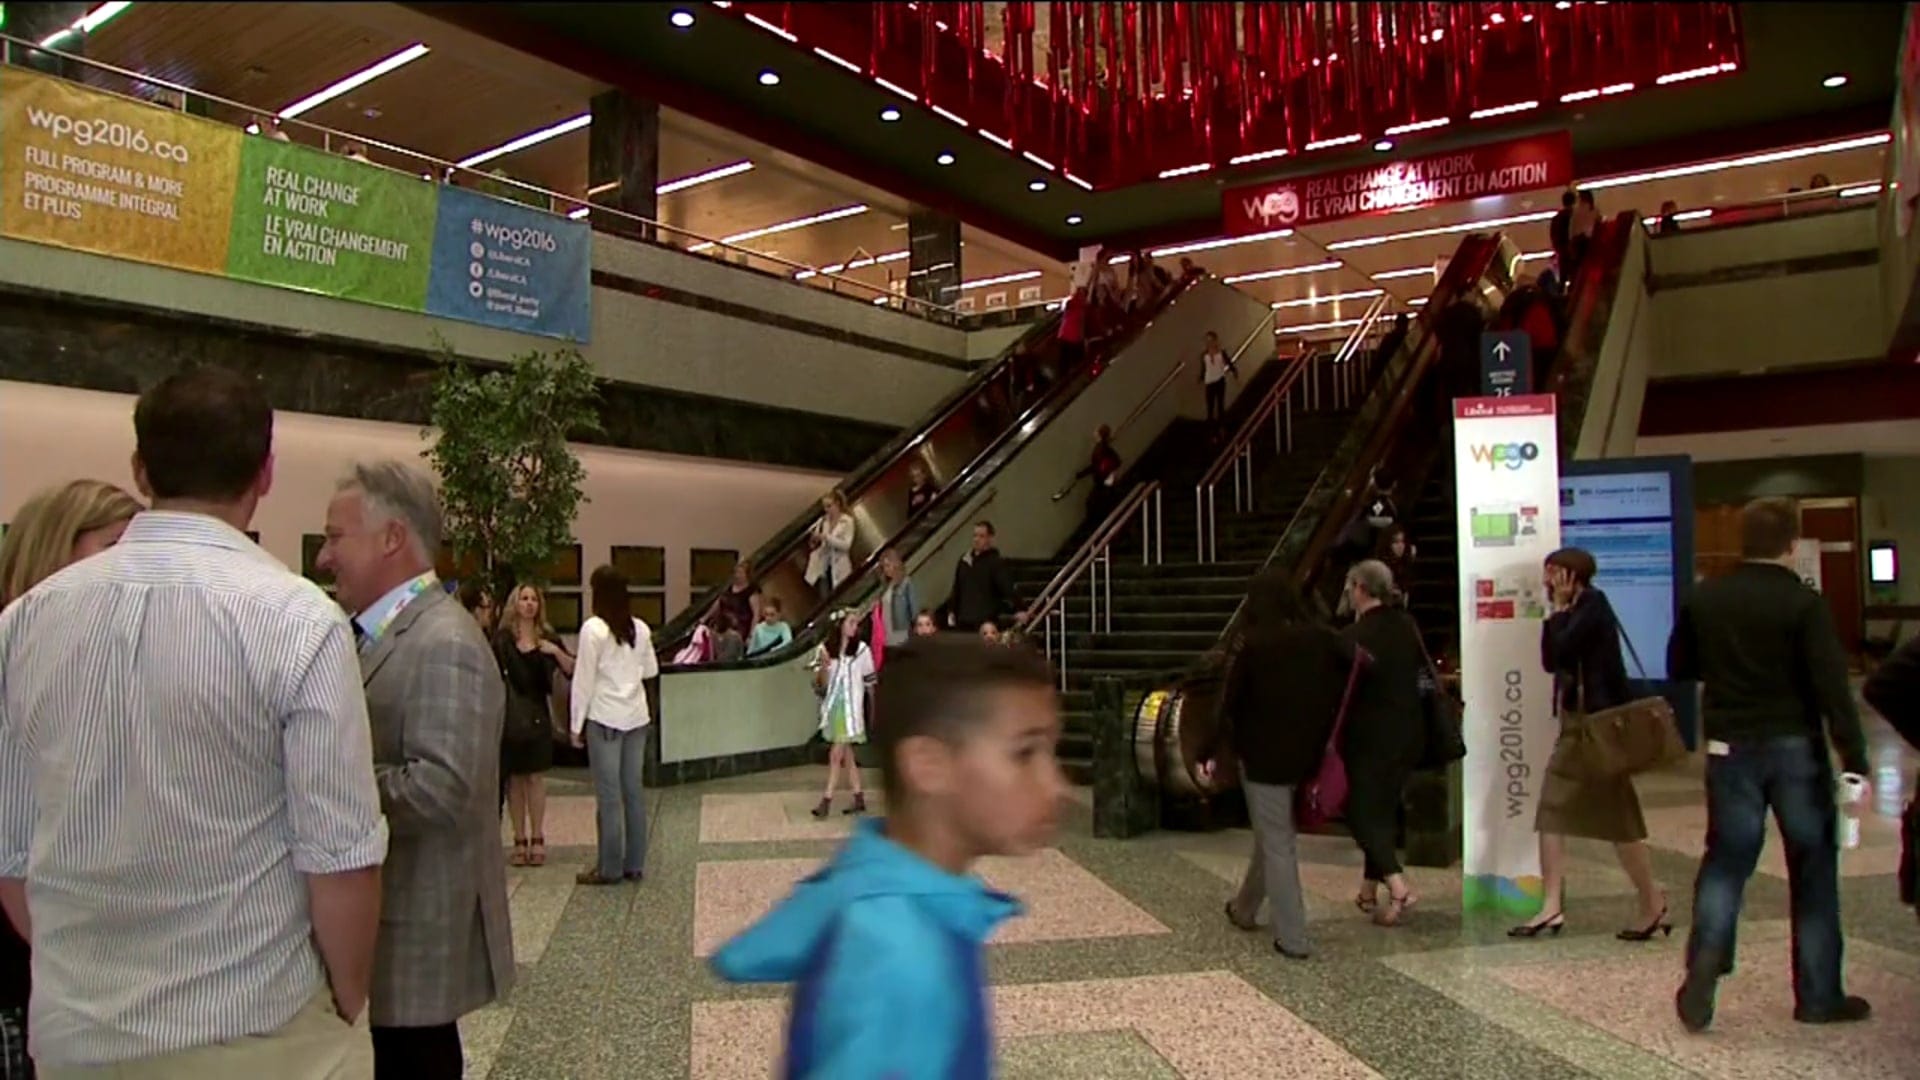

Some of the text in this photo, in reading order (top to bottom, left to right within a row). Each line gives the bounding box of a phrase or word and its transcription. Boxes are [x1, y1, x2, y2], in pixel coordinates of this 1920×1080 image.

[27, 105, 188, 163] wpg2016.ca
[24, 170, 117, 207] PROGRAMME
[25, 145, 184, 198] FULL PROGRAM & MORE
[266, 165, 361, 206] REAL CHANGE
[1305, 161, 1548, 220] LE VRAI CHANGEMENT EN ACTION
[1306, 153, 1476, 200] REAL CHANGE AT WORK
[23, 192, 82, 219] ET PLUS
[264, 186, 329, 218] AT WORK
[263, 234, 337, 266] EN ACTION
[265, 213, 409, 261] LE VRAI CHANGEMENT
[471, 218, 556, 253] #wpg2016
[1500, 669, 1531, 819] wpg2016.ca
